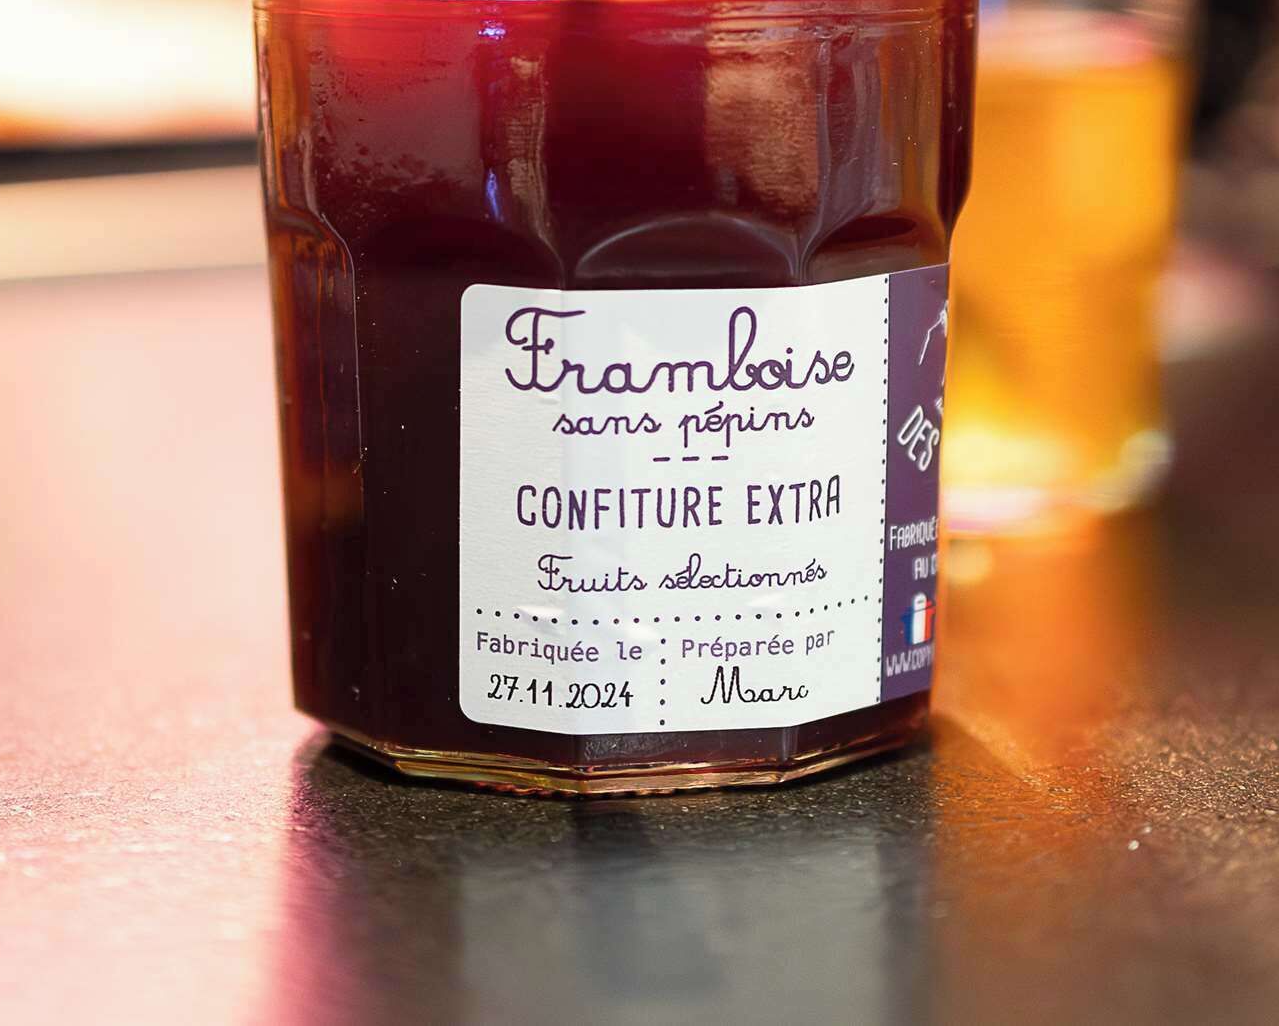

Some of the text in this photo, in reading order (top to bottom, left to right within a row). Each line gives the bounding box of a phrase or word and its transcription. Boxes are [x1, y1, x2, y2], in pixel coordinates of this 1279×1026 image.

[505, 306, 855, 393] Framboise
[552, 401, 815, 448] sans pépins
[897, 405, 940, 472] DES
[516, 474, 841, 530] CONFITURE EXTRA
[537, 553, 827, 593] Fruits sélectionnés
[476, 631, 643, 664] Fabriquée le
[681, 629, 835, 662] Préparée par
[487, 675, 634, 709] 27.11.2024
[700, 665, 810, 705] Marc
